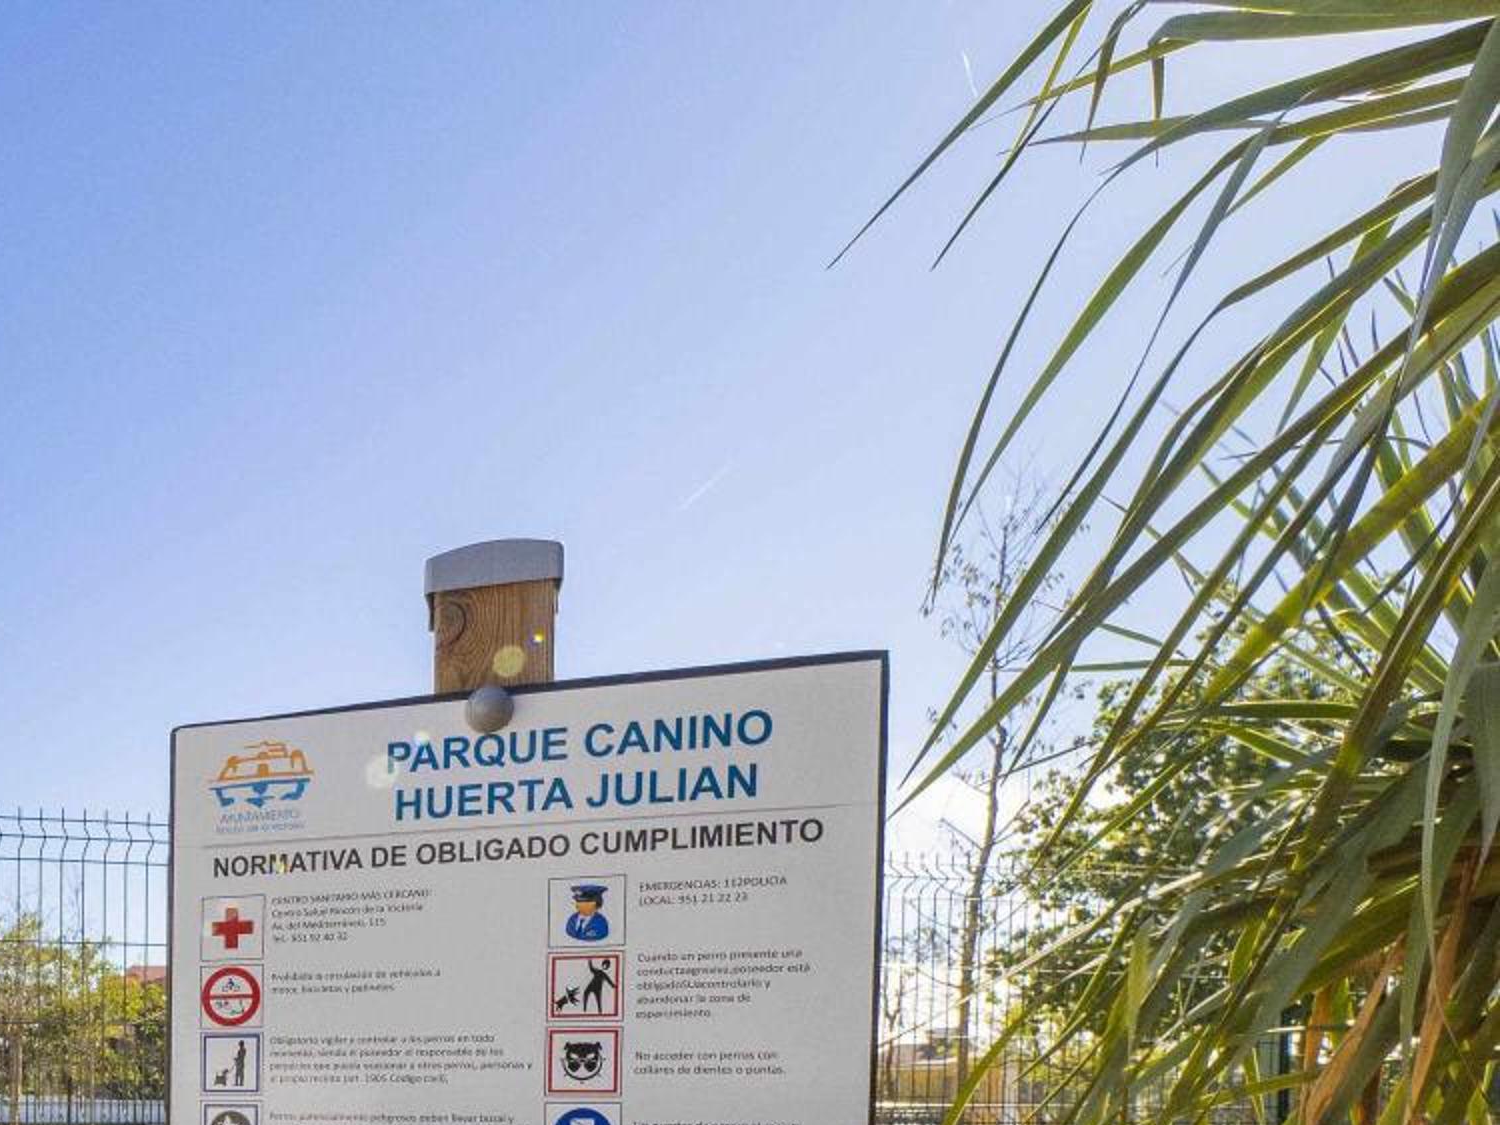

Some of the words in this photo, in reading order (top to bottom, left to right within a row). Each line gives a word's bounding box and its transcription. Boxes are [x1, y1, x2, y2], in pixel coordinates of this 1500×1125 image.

[387, 727, 568, 774] PARQUE
[585, 709, 773, 756] CANINO
[396, 777, 572, 821] HUERTA
[587, 763, 759, 810] JULIAN
[213, 848, 366, 878] NORMATIVA
[371, 845, 406, 868] DE
[415, 833, 572, 866] OBLIGADO
[580, 818, 823, 856] CUMPLIMIENTO
[639, 879, 721, 892] EMERGENCIAS:
[678, 894, 697, 904] 951
[701, 893, 713, 903] 21
[717, 892, 731, 903] 22
[637, 953, 678, 962] Cuando
[698, 953, 727, 962] perro
[729, 950, 779, 961] presente
[781, 950, 803, 959] una
[708, 995, 734, 1003] zona
[737, 993, 751, 1003] de
[635, 1051, 650, 1060] No
[653, 1051, 694, 1060] acceder
[697, 1052, 717, 1060] con
[719, 1052, 754, 1062] perros
[634, 1066, 674, 1075] collares
[677, 1066, 690, 1075] de
[694, 1066, 732, 1075] dientes
